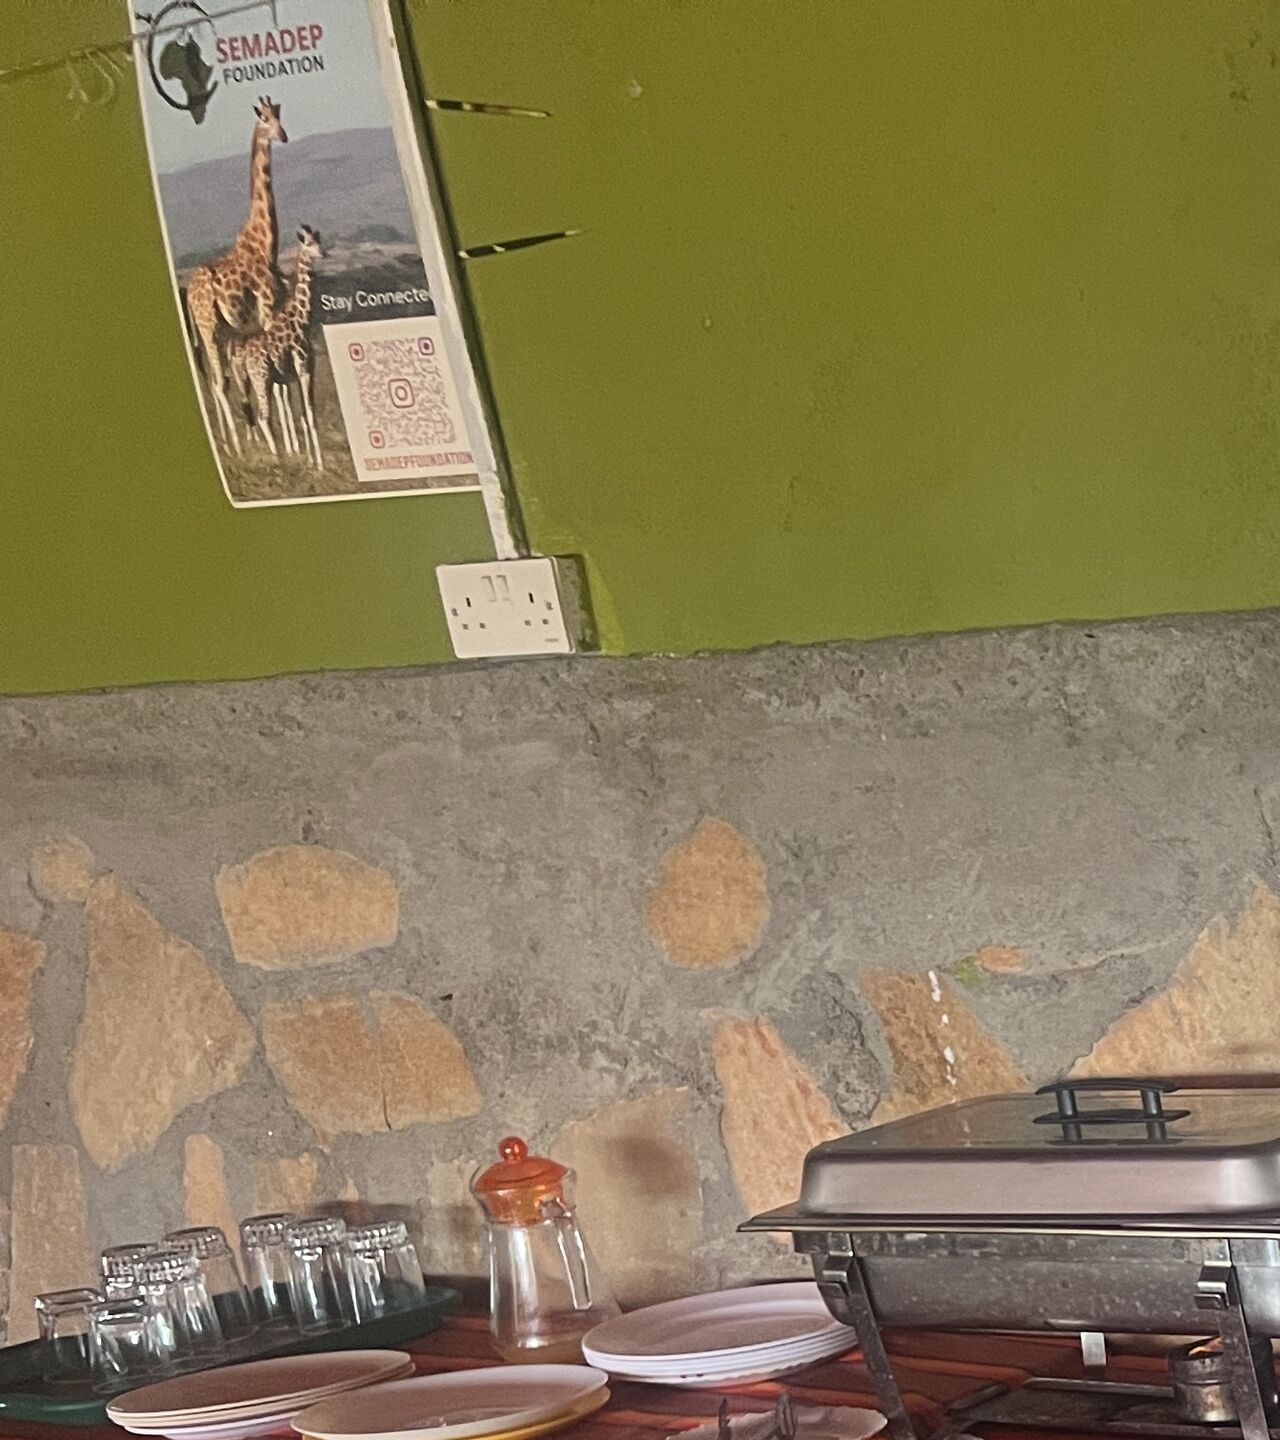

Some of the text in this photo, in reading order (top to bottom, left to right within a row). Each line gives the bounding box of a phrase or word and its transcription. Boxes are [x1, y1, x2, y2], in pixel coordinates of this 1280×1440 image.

[216, 24, 323, 63] SEMADEP
[222, 55, 325, 84] FOUNDATION
[320, 287, 432, 312] Stay Connecte
